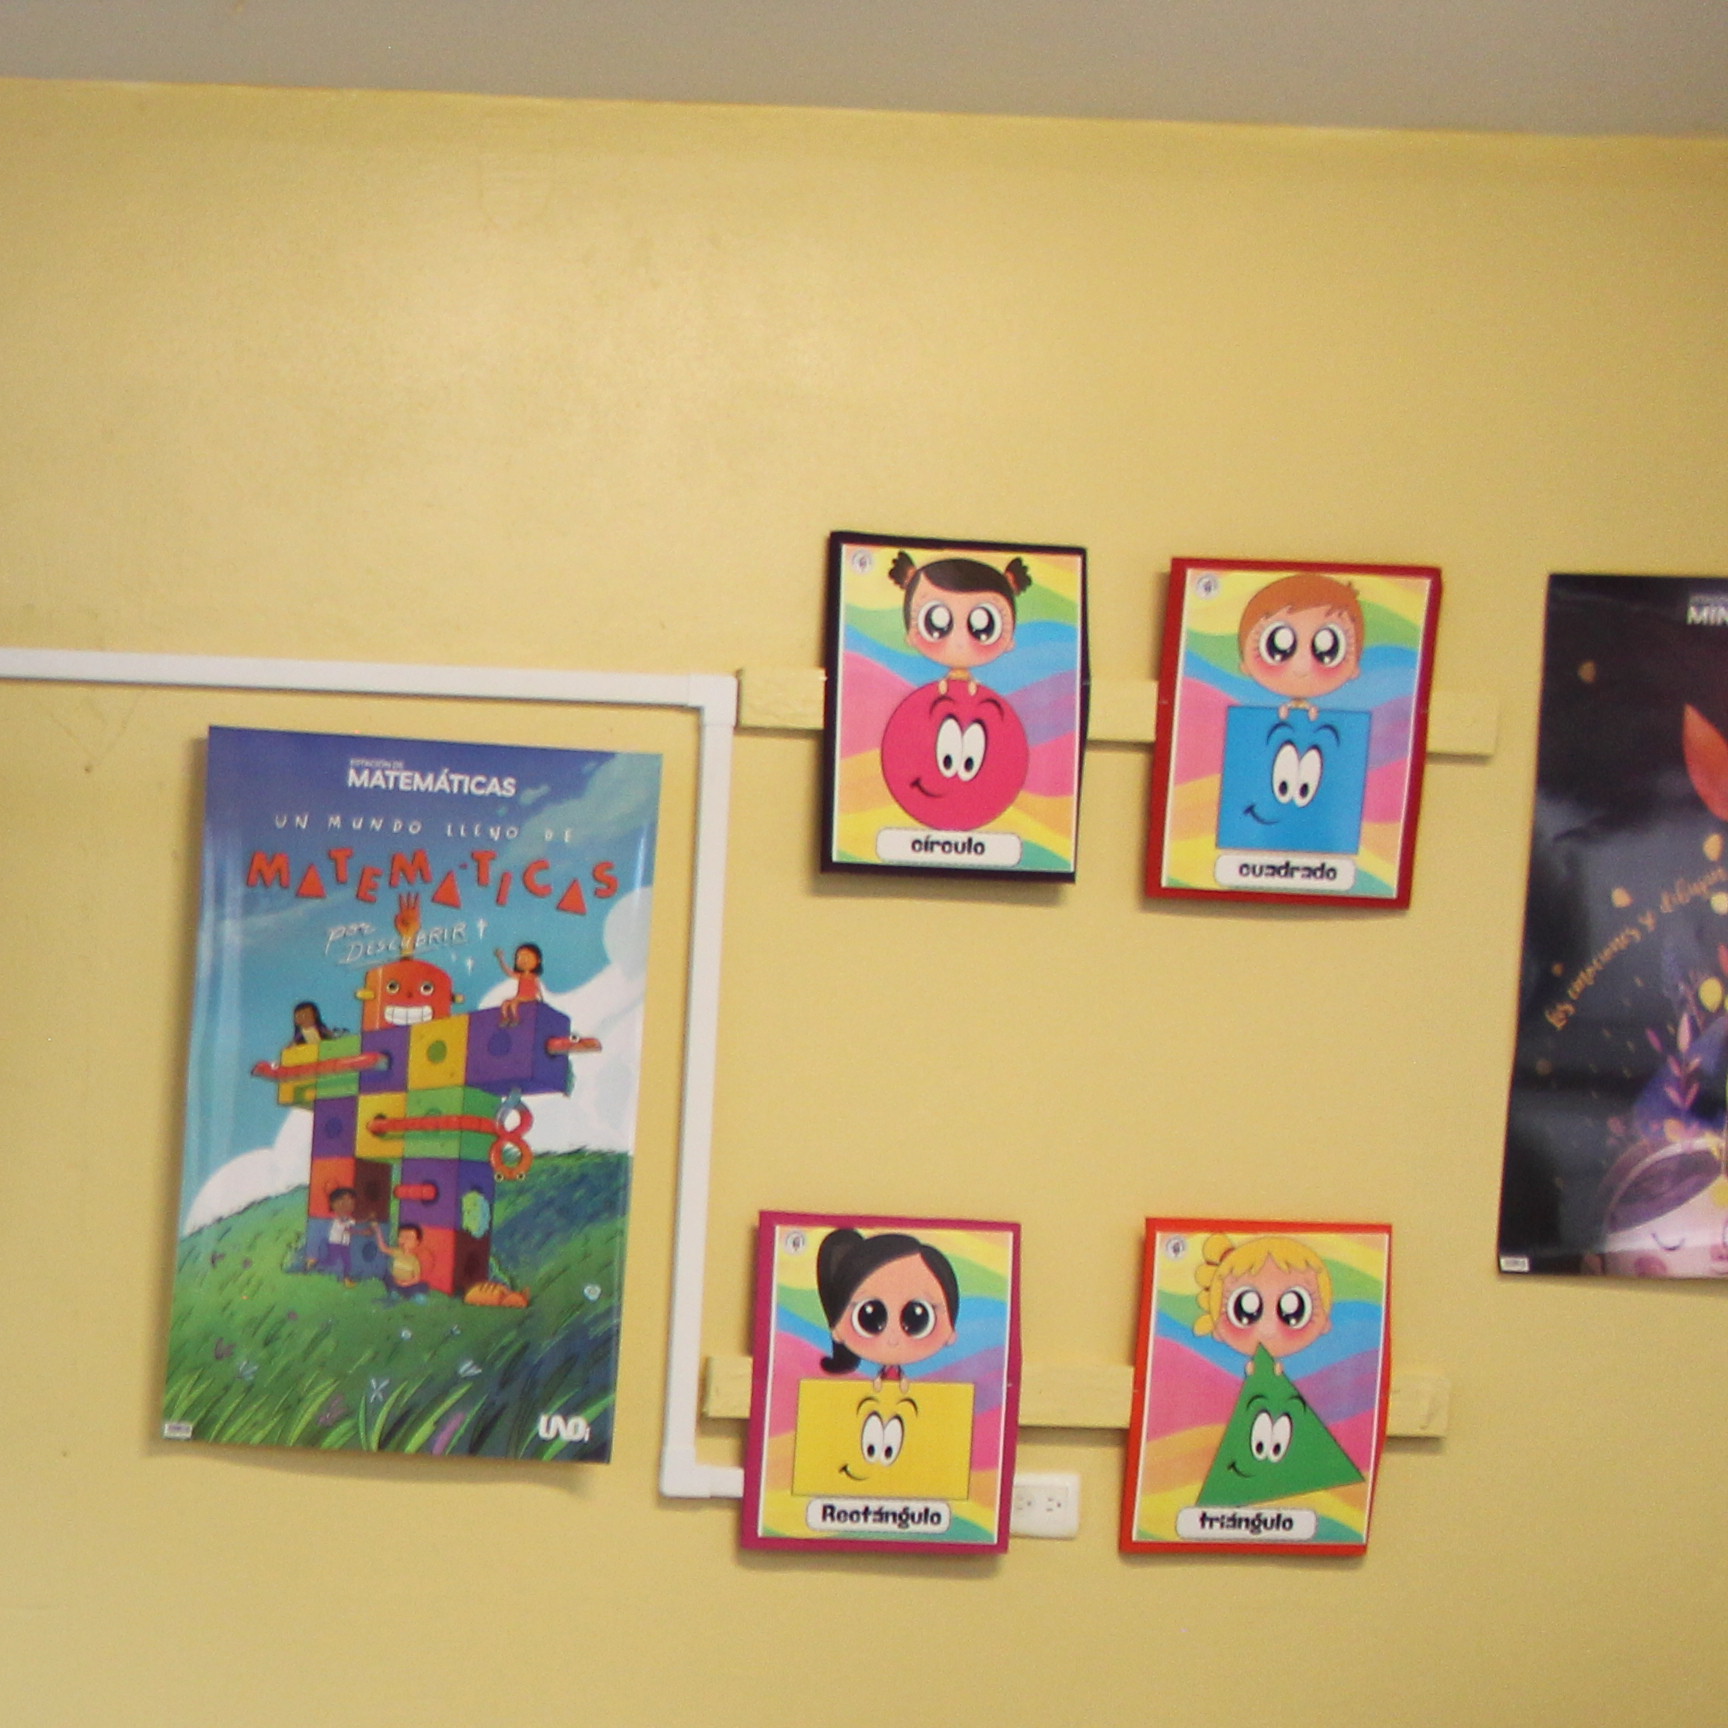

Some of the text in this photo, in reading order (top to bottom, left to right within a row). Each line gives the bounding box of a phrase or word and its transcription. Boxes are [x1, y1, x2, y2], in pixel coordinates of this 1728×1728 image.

[348, 768, 516, 797] MATEMÁTICAS
[275, 814, 309, 830] UN
[328, 815, 422, 834] MUNDO
[545, 828, 573, 843] DE
[911, 835, 986, 855] círculo
[1239, 860, 1338, 880] cuadrado
[821, 1504, 942, 1529] Rectángulo
[1200, 1511, 1294, 1535] triángulo
